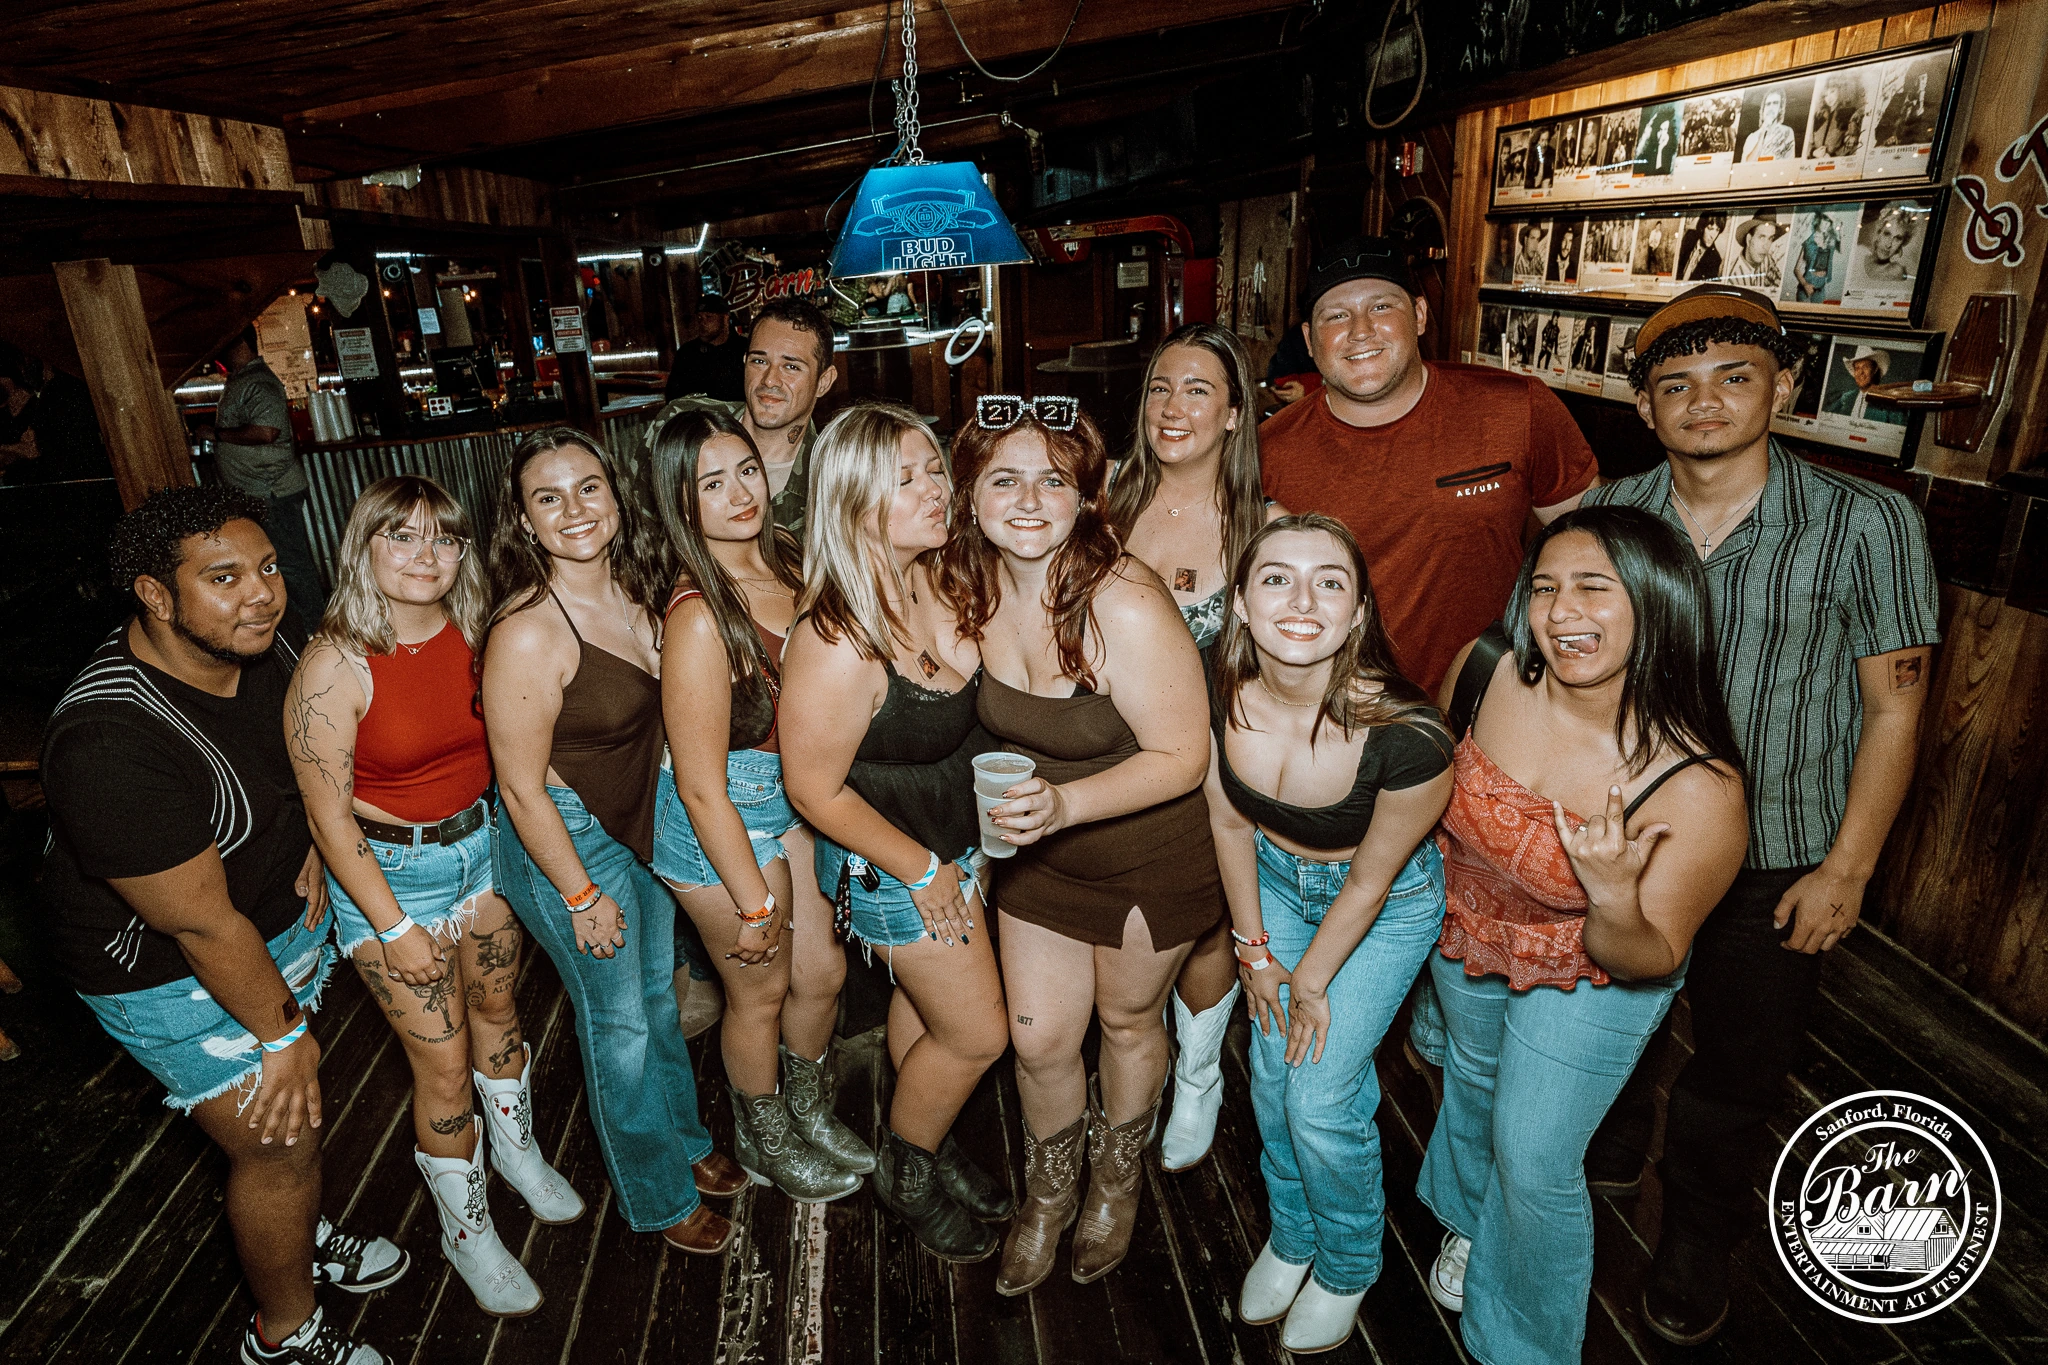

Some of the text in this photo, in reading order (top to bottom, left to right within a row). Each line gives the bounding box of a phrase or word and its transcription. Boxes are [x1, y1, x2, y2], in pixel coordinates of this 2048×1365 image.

[901, 237, 954, 257] BUD
[893, 252, 967, 270] LIGHT
[722, 262, 815, 313] Barn
[988, 404, 1068, 422] 21 21
[1456, 481, 1501, 498] AE/USA
